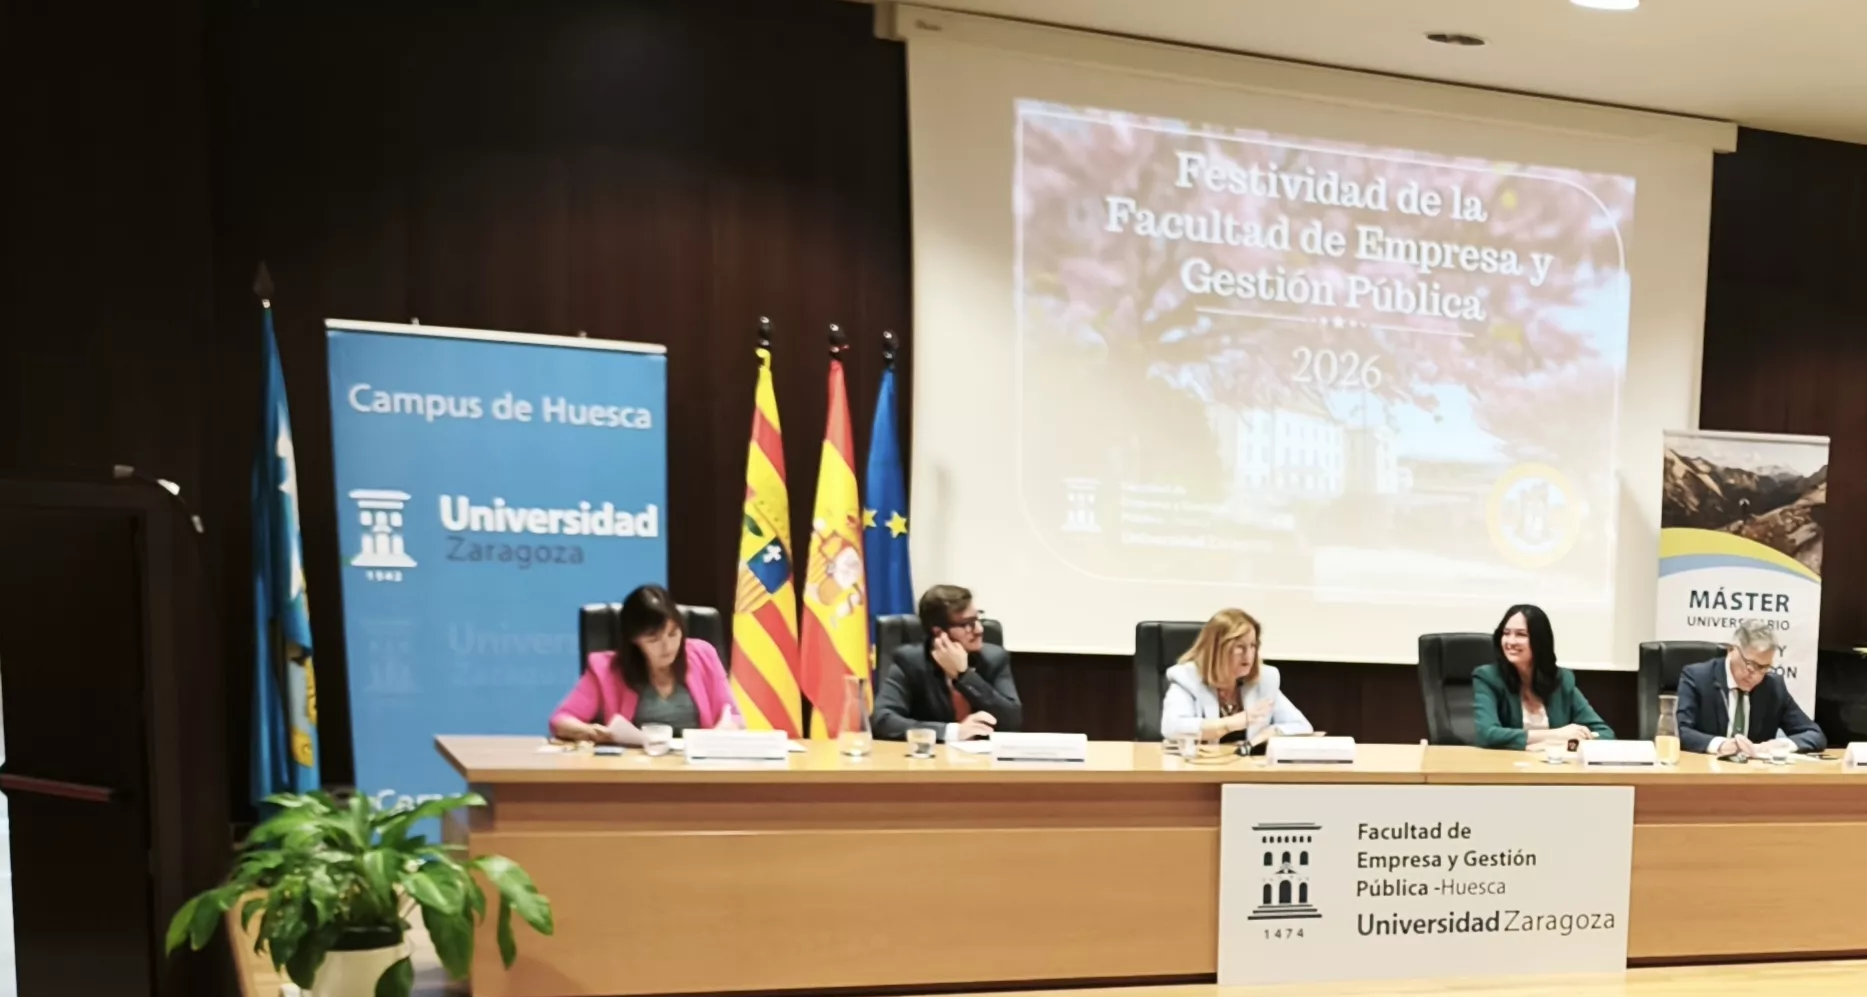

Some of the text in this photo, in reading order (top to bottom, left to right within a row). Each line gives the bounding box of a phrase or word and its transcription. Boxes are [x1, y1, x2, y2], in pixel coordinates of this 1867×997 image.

[1174, 149, 1488, 222] Festividad de la
[1104, 196, 1555, 287] Facultad de Empresa y
[1180, 257, 1487, 321] Gestión Pública
[1291, 346, 1383, 390] 2026
[348, 383, 653, 429] Campus de Huesca
[438, 494, 659, 538] Universidad
[445, 536, 585, 570] Zaragoza
[1689, 587, 1790, 612] MÁSTER
[1687, 616, 1790, 631] UNIVERRIO
[1358, 821, 1472, 840] Facultad de
[1357, 849, 1537, 873] Empresa y Gestión
[1357, 878, 1429, 897] Pública
[1264, 928, 1304, 940] 1474
[1357, 909, 1615, 936] Universidad Zaragoza
